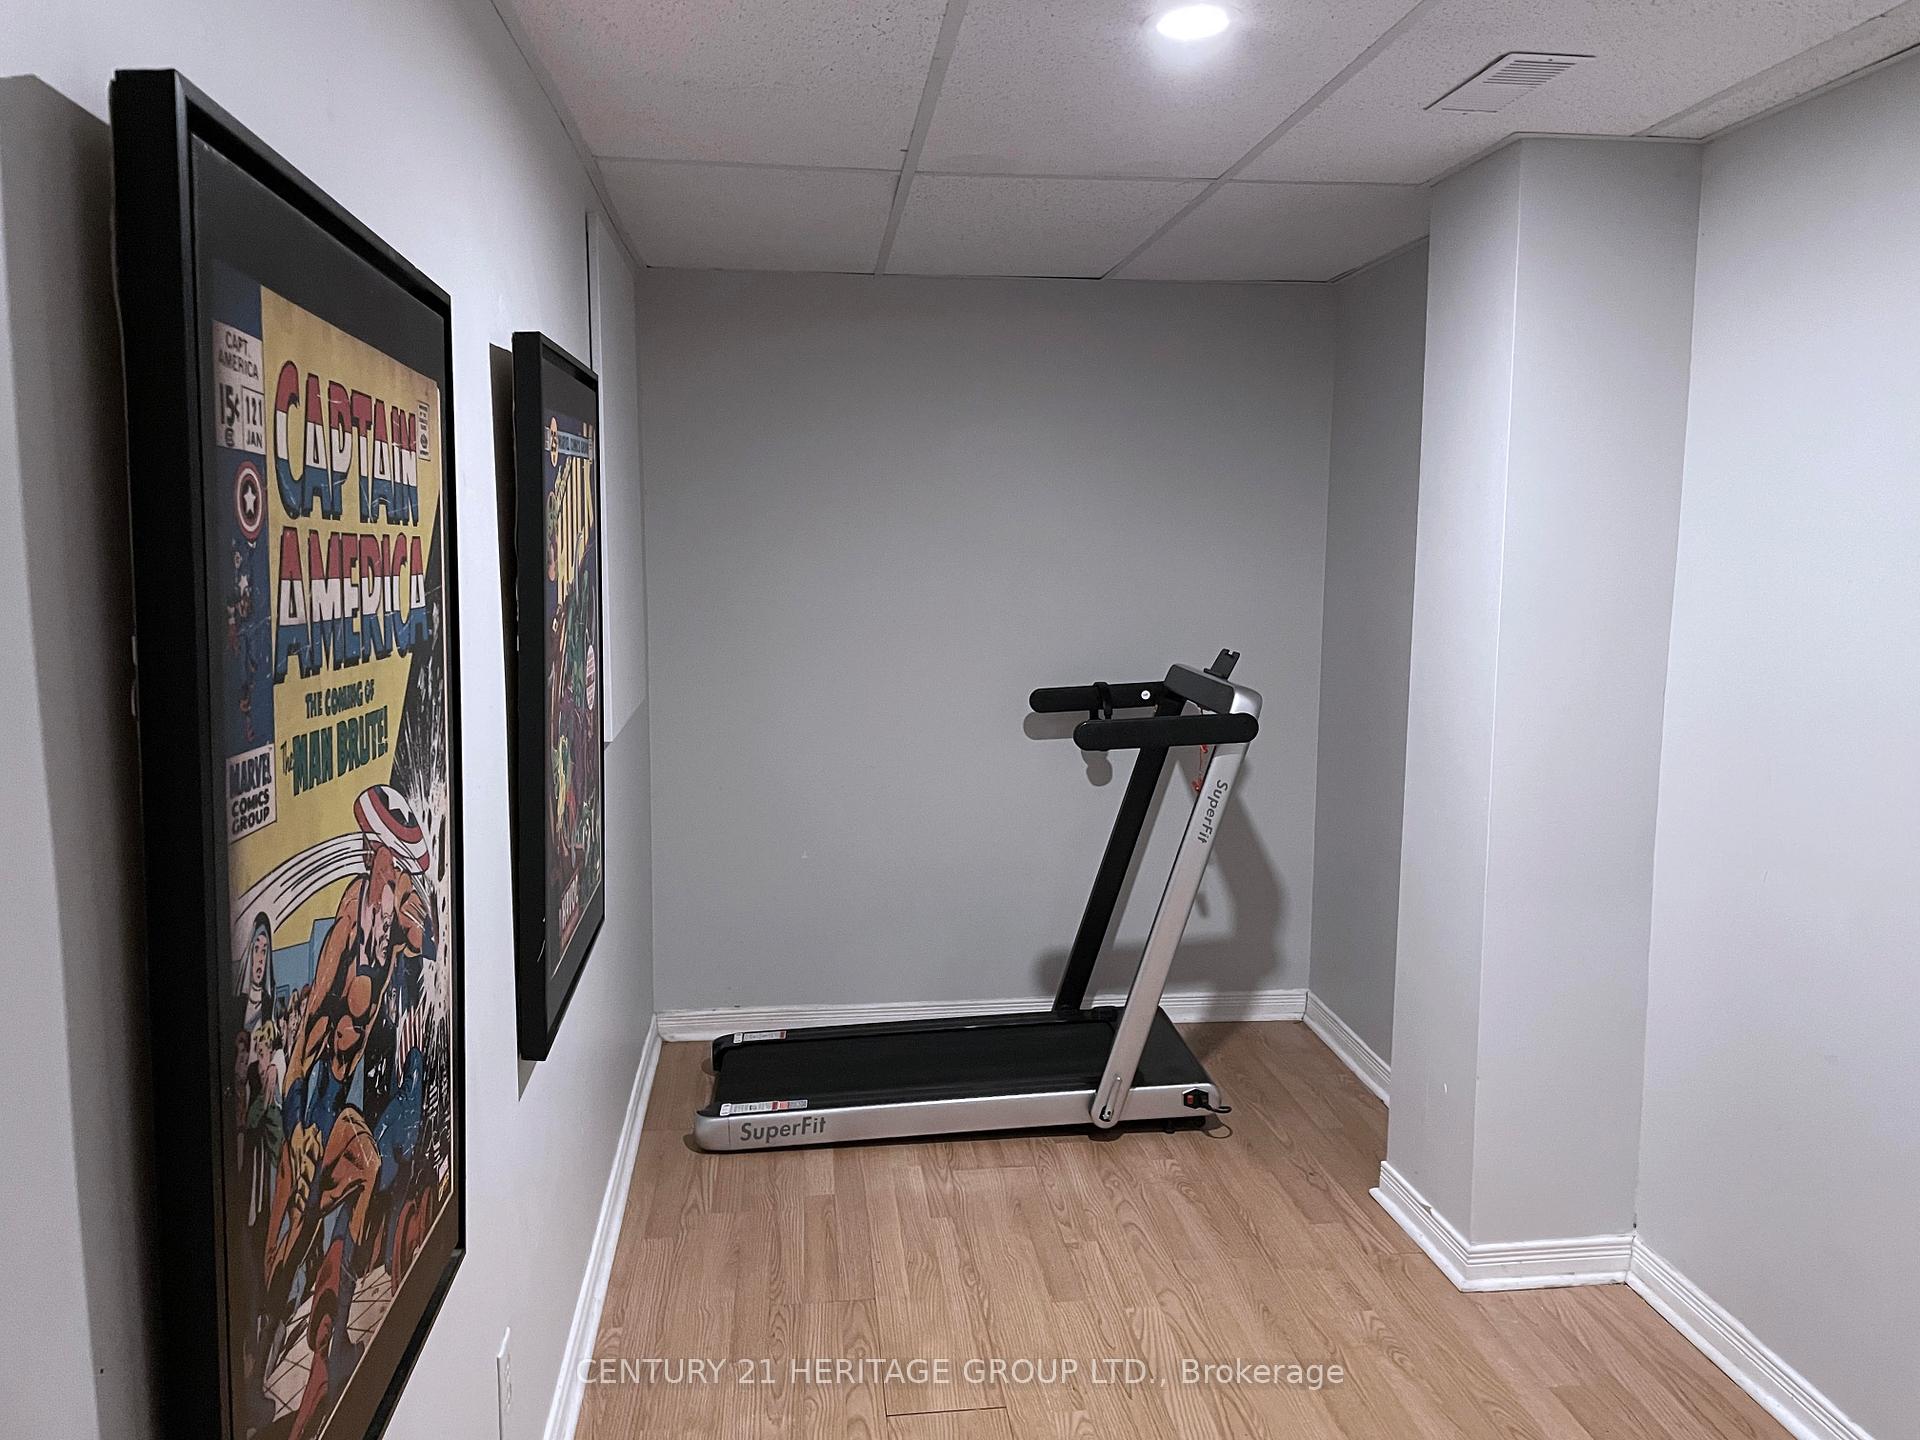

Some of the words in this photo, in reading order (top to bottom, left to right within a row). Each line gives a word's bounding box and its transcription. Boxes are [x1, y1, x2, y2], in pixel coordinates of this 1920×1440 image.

[218, 350, 259, 380] AMERICA
[245, 395, 263, 426] 121
[246, 429, 263, 449] JAN
[274, 360, 418, 526] CAPTAIN
[273, 527, 428, 684] AMERICA
[305, 691, 323, 719] THE
[325, 682, 363, 716] COMING
[364, 679, 375, 705] OF
[229, 752, 271, 798] MARVEL
[293, 726, 333, 796] MAN
[231, 789, 270, 818] COMICS
[232, 807, 270, 835] GROUP
[1198, 779, 1228, 844] SuperFit
[740, 1116, 826, 1143] SuperFit
